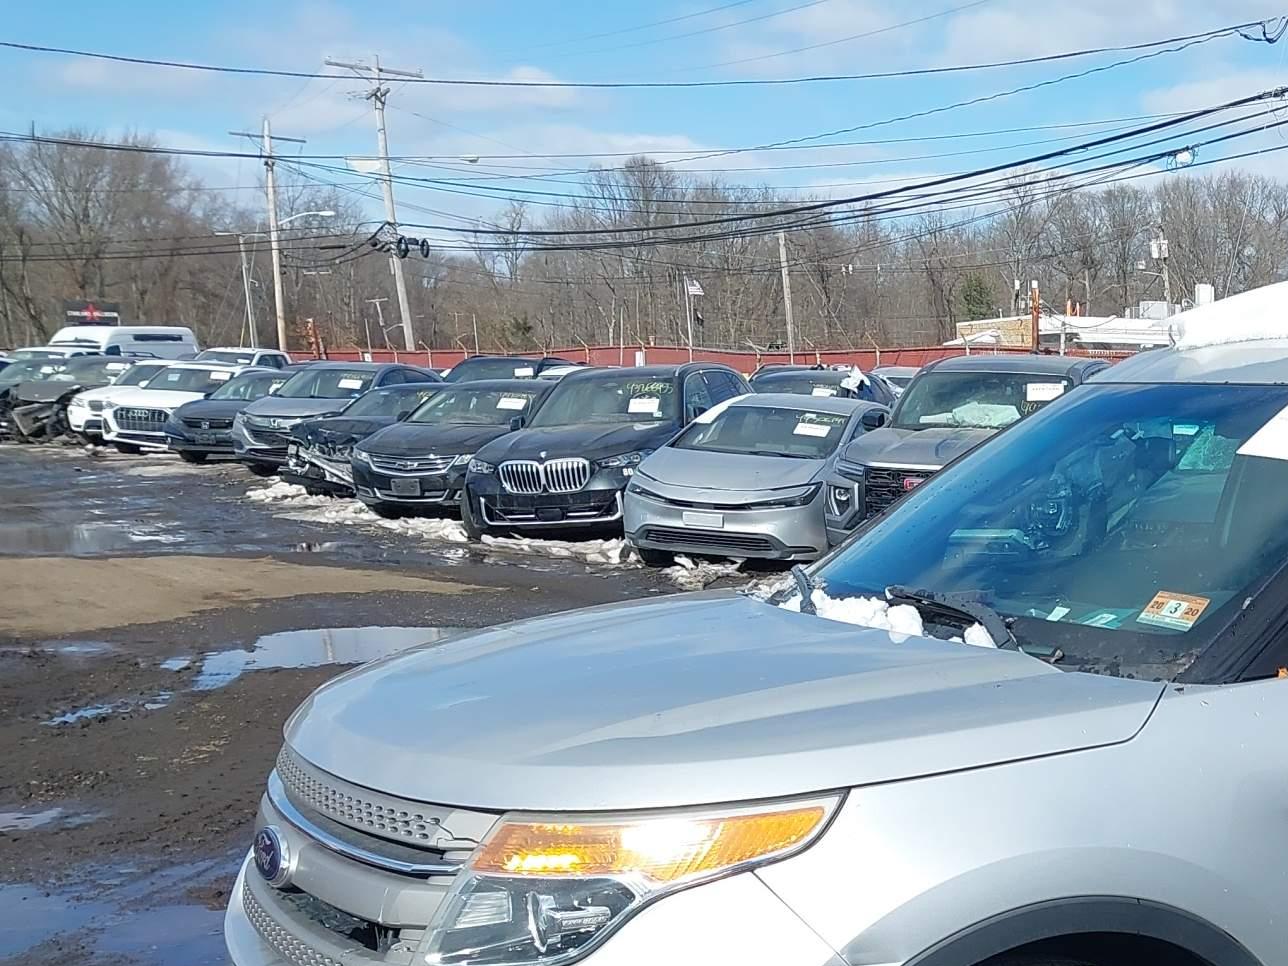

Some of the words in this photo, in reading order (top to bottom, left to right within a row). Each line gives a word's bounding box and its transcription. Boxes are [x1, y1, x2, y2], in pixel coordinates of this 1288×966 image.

[1150, 600, 1165, 610] 20
[1169, 602, 1182, 614] 3
[1184, 607, 1200, 616] 20
